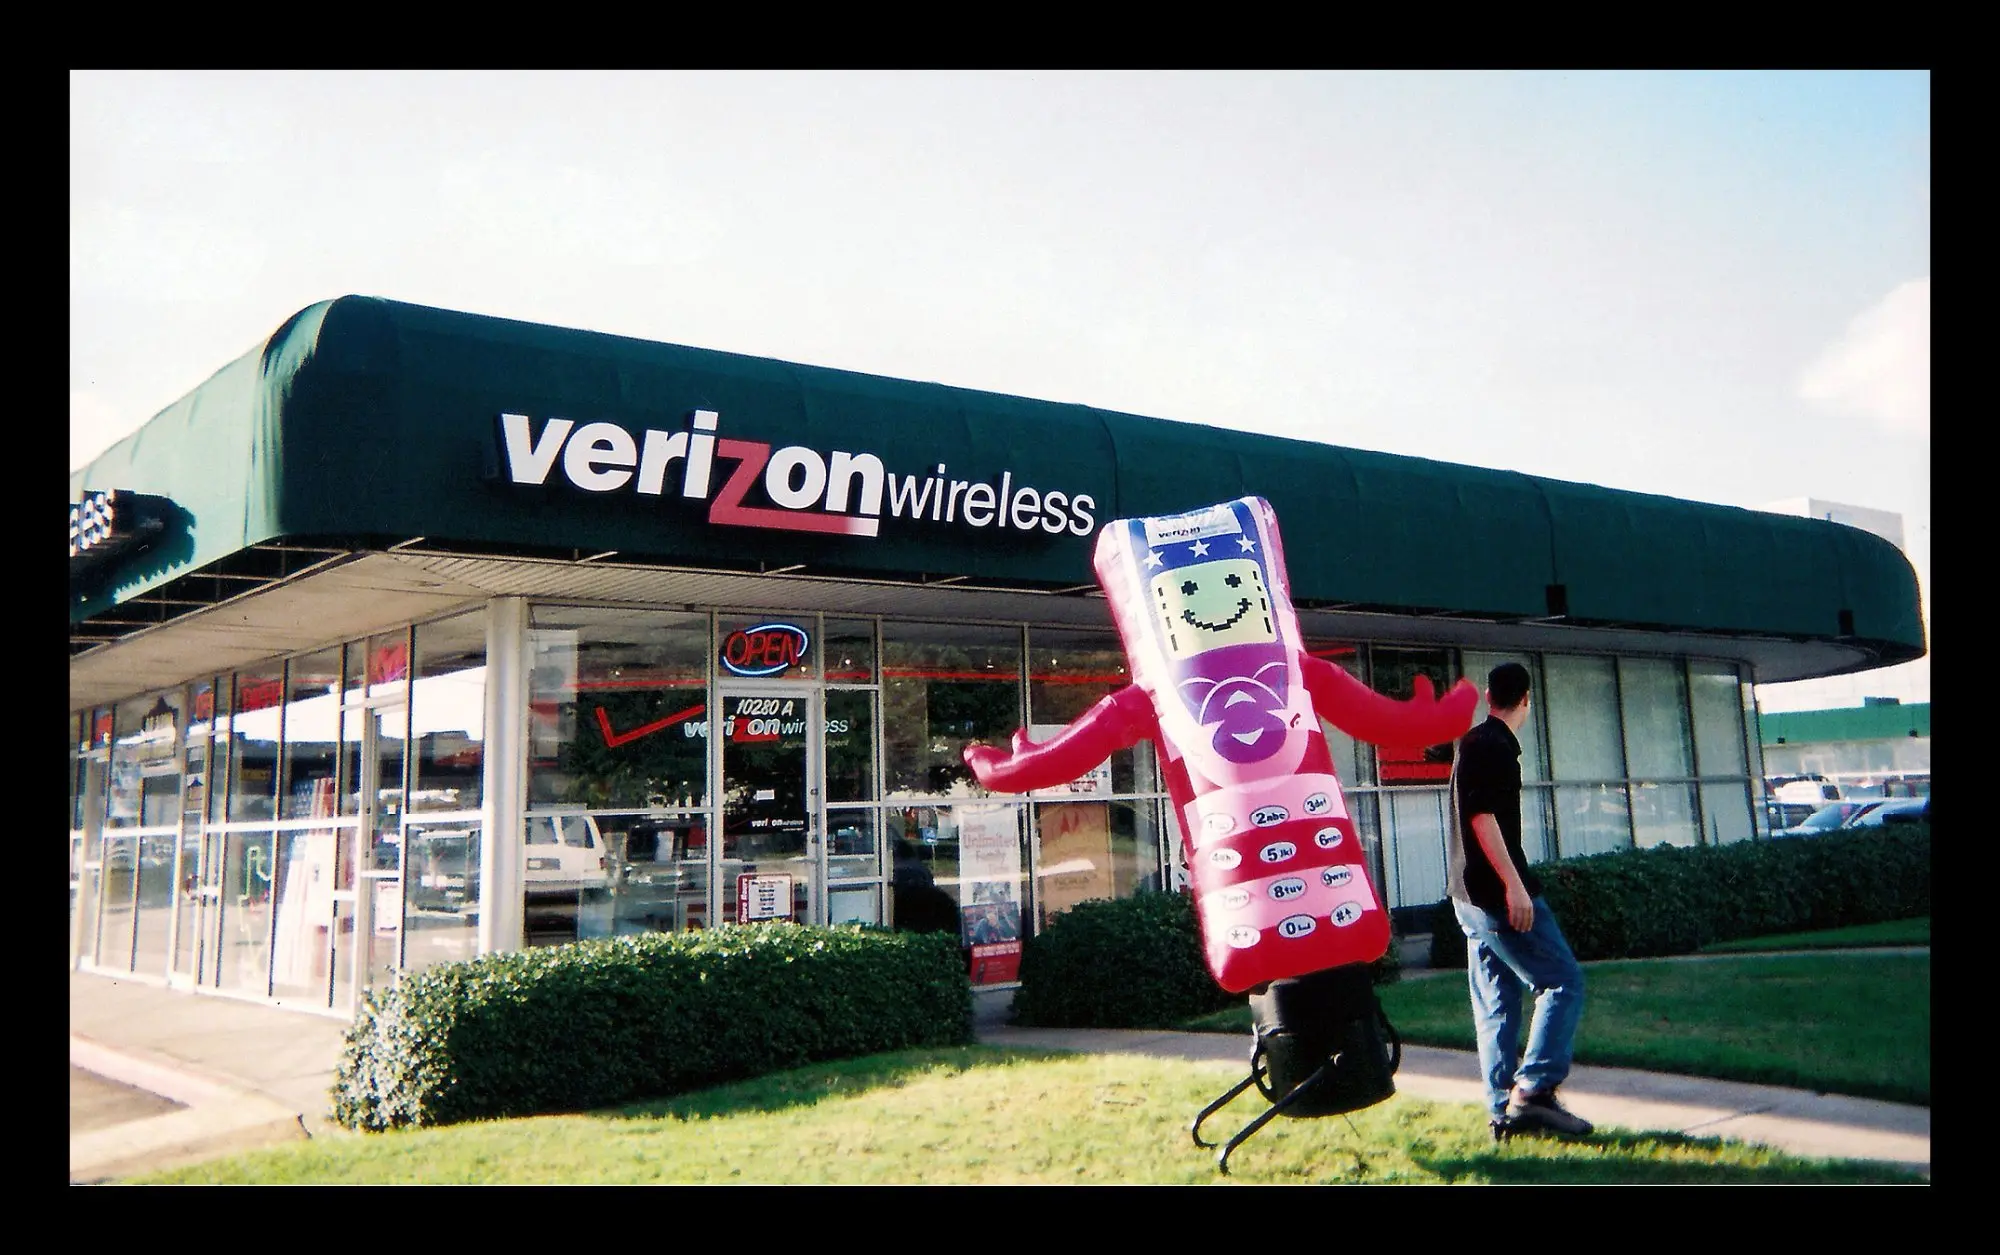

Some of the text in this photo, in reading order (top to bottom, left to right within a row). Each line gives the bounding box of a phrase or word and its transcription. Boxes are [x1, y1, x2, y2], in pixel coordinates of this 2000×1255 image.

[501, 410, 1094, 537] verizon wireless
[726, 630, 802, 667] OPEN
[736, 699, 794, 716] 10280 A
